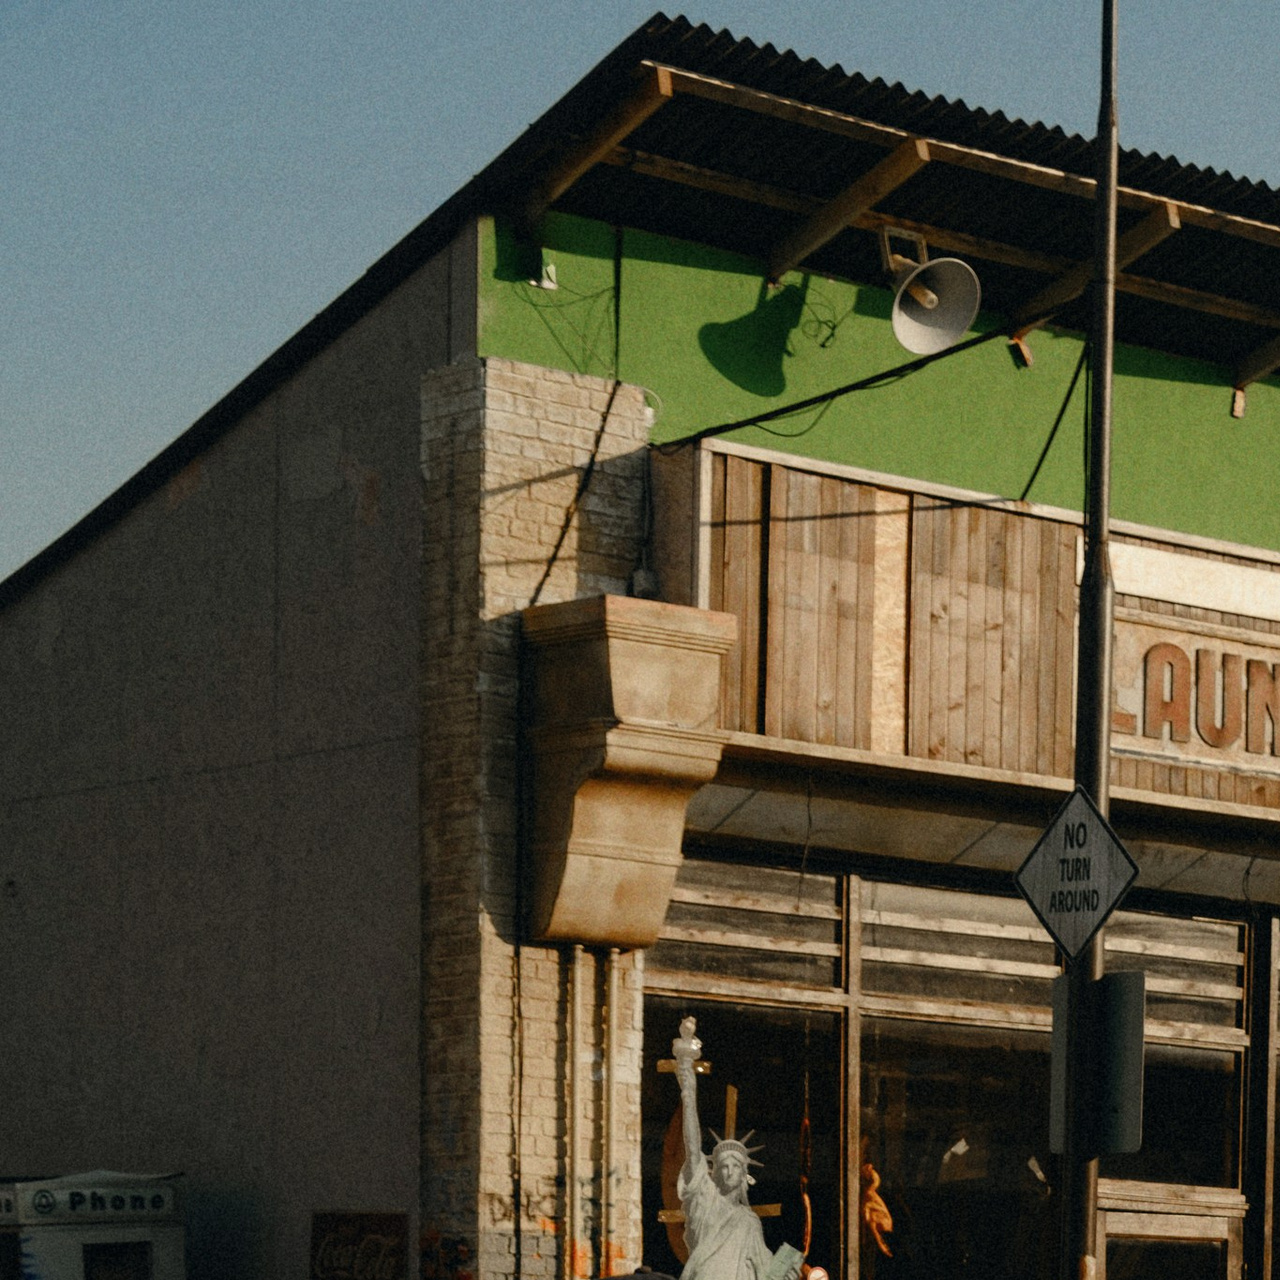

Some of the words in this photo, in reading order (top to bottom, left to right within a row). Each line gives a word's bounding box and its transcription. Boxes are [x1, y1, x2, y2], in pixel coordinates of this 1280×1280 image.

[1064, 822, 1087, 849] NO
[1059, 857, 1091, 882] TURN
[1050, 888, 1099, 913] AROUND
[69, 1190, 165, 1211] Phone
